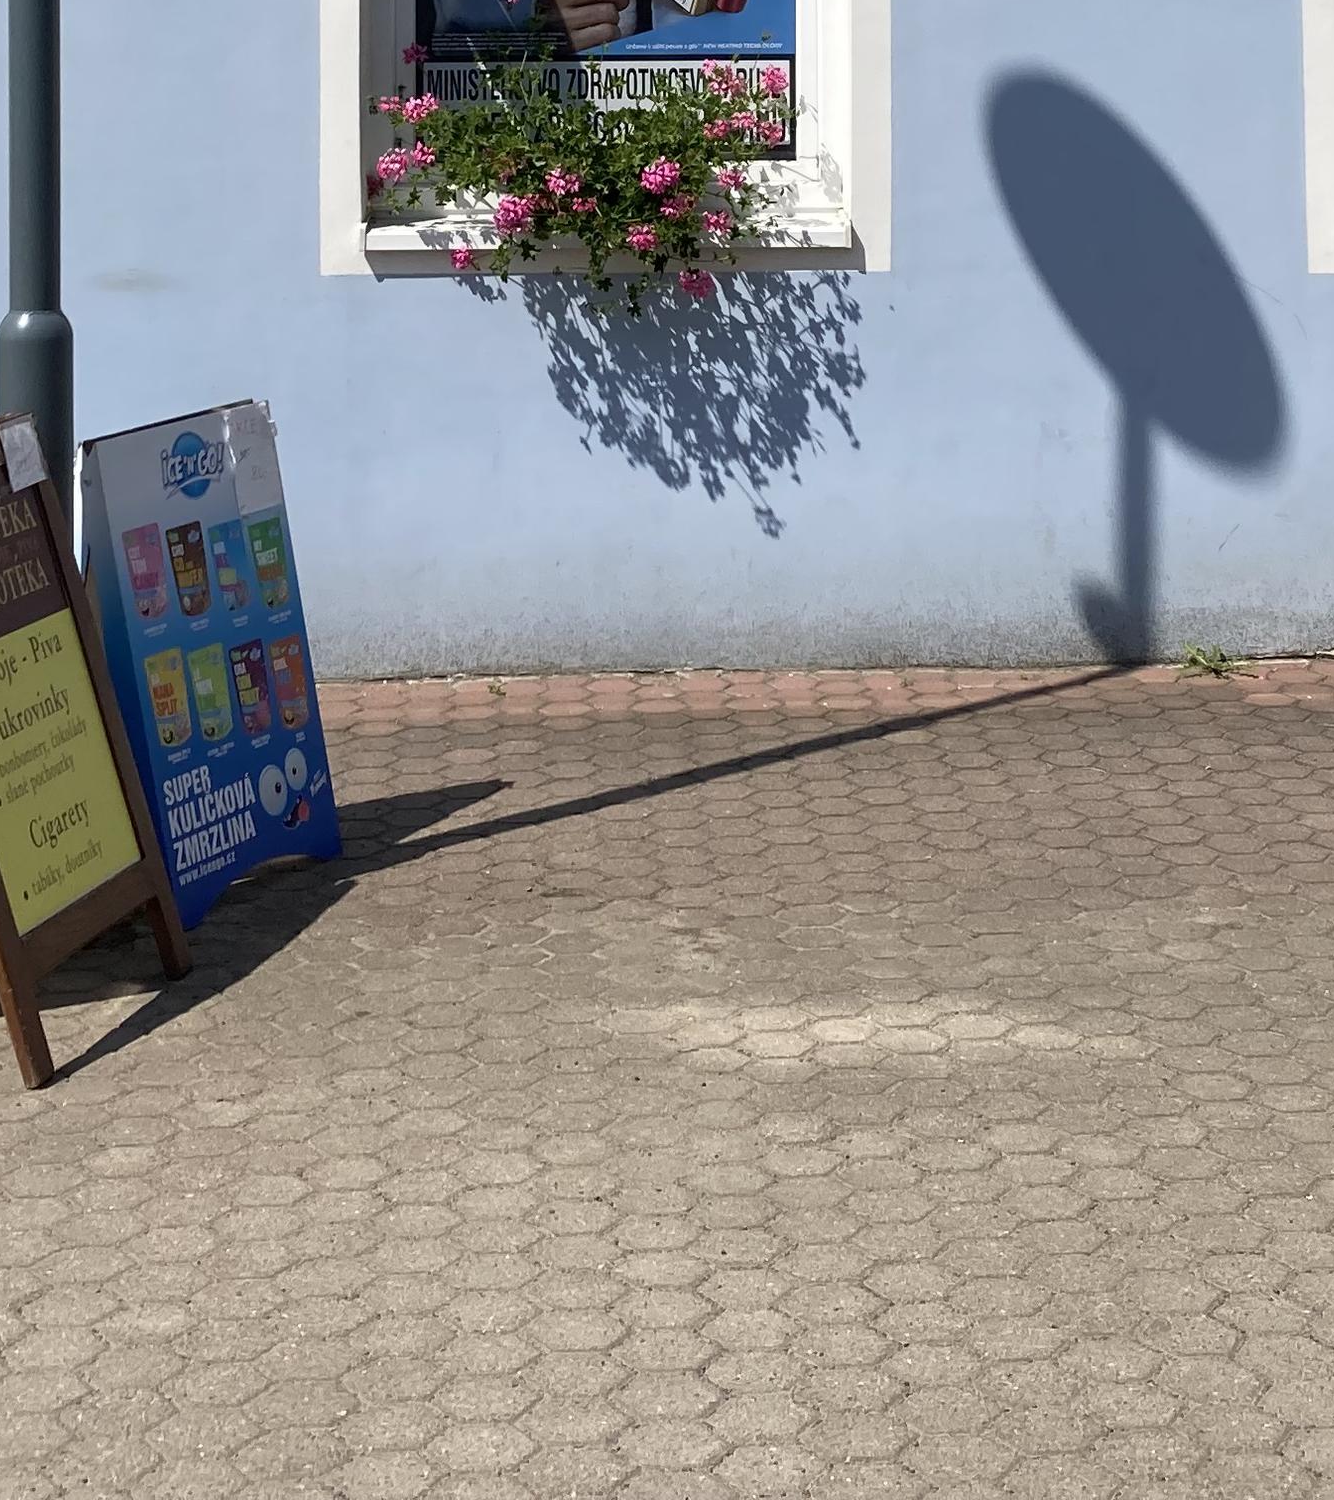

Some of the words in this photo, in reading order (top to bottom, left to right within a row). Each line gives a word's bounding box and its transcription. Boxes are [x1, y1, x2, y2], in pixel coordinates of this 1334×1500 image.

[28, 632, 63, 663] Piva
[51, 716, 87, 748] čokolády
[30, 753, 75, 795] pochoutky
[163, 765, 211, 805] SUPER
[29, 799, 89, 848] Cigarety
[168, 772, 256, 839] KULIČKOVÁ
[173, 810, 256, 872] ZMRZLINA
[32, 865, 65, 895] tabáky,
[65, 839, 103, 874] doutníky
